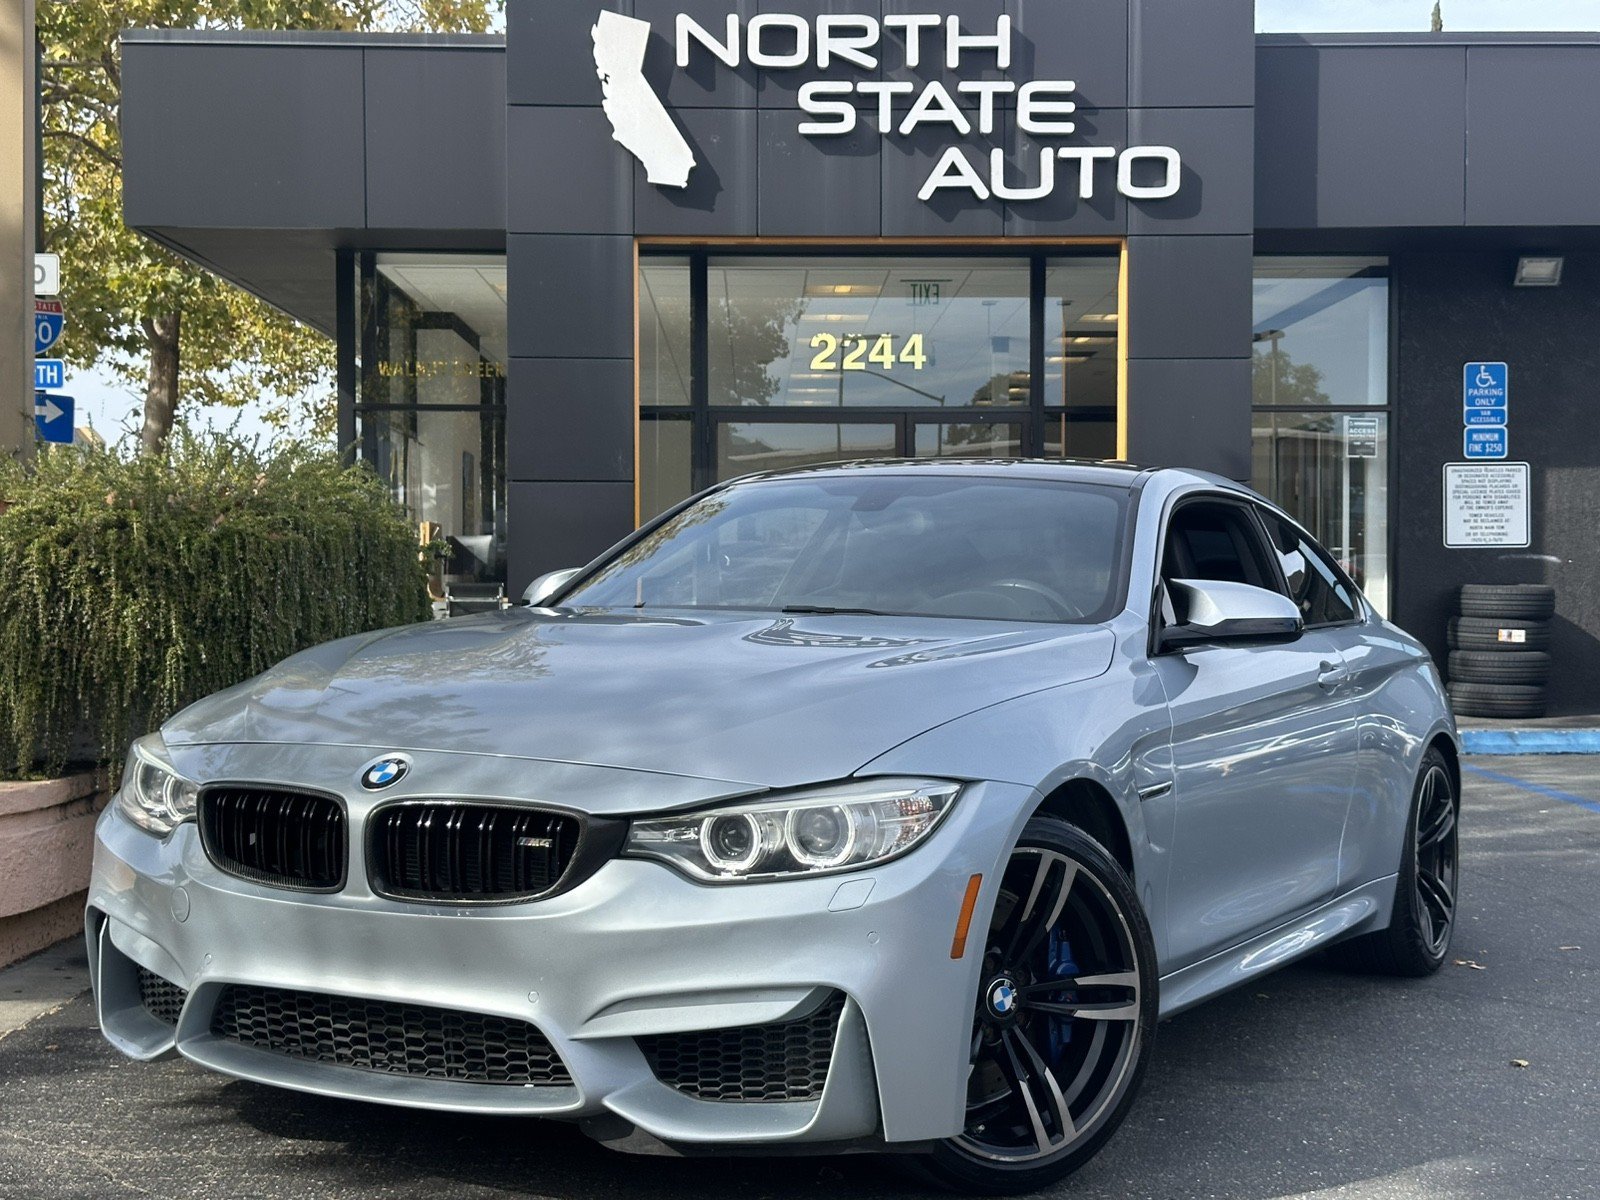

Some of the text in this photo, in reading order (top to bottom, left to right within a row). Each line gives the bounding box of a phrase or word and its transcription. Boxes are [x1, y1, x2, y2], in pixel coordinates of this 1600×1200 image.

[675, 13, 1011, 69] NORTH
[798, 80, 1077, 136] STATE
[917, 145, 1182, 201] AUTO
[809, 332, 927, 370] 2244
[1468, 388, 1503, 396] PARKING
[1474, 398, 1496, 406] ONLY
[1468, 443, 1503, 453] FINE $250
[1472, 433, 1499, 441] MINIMUM
